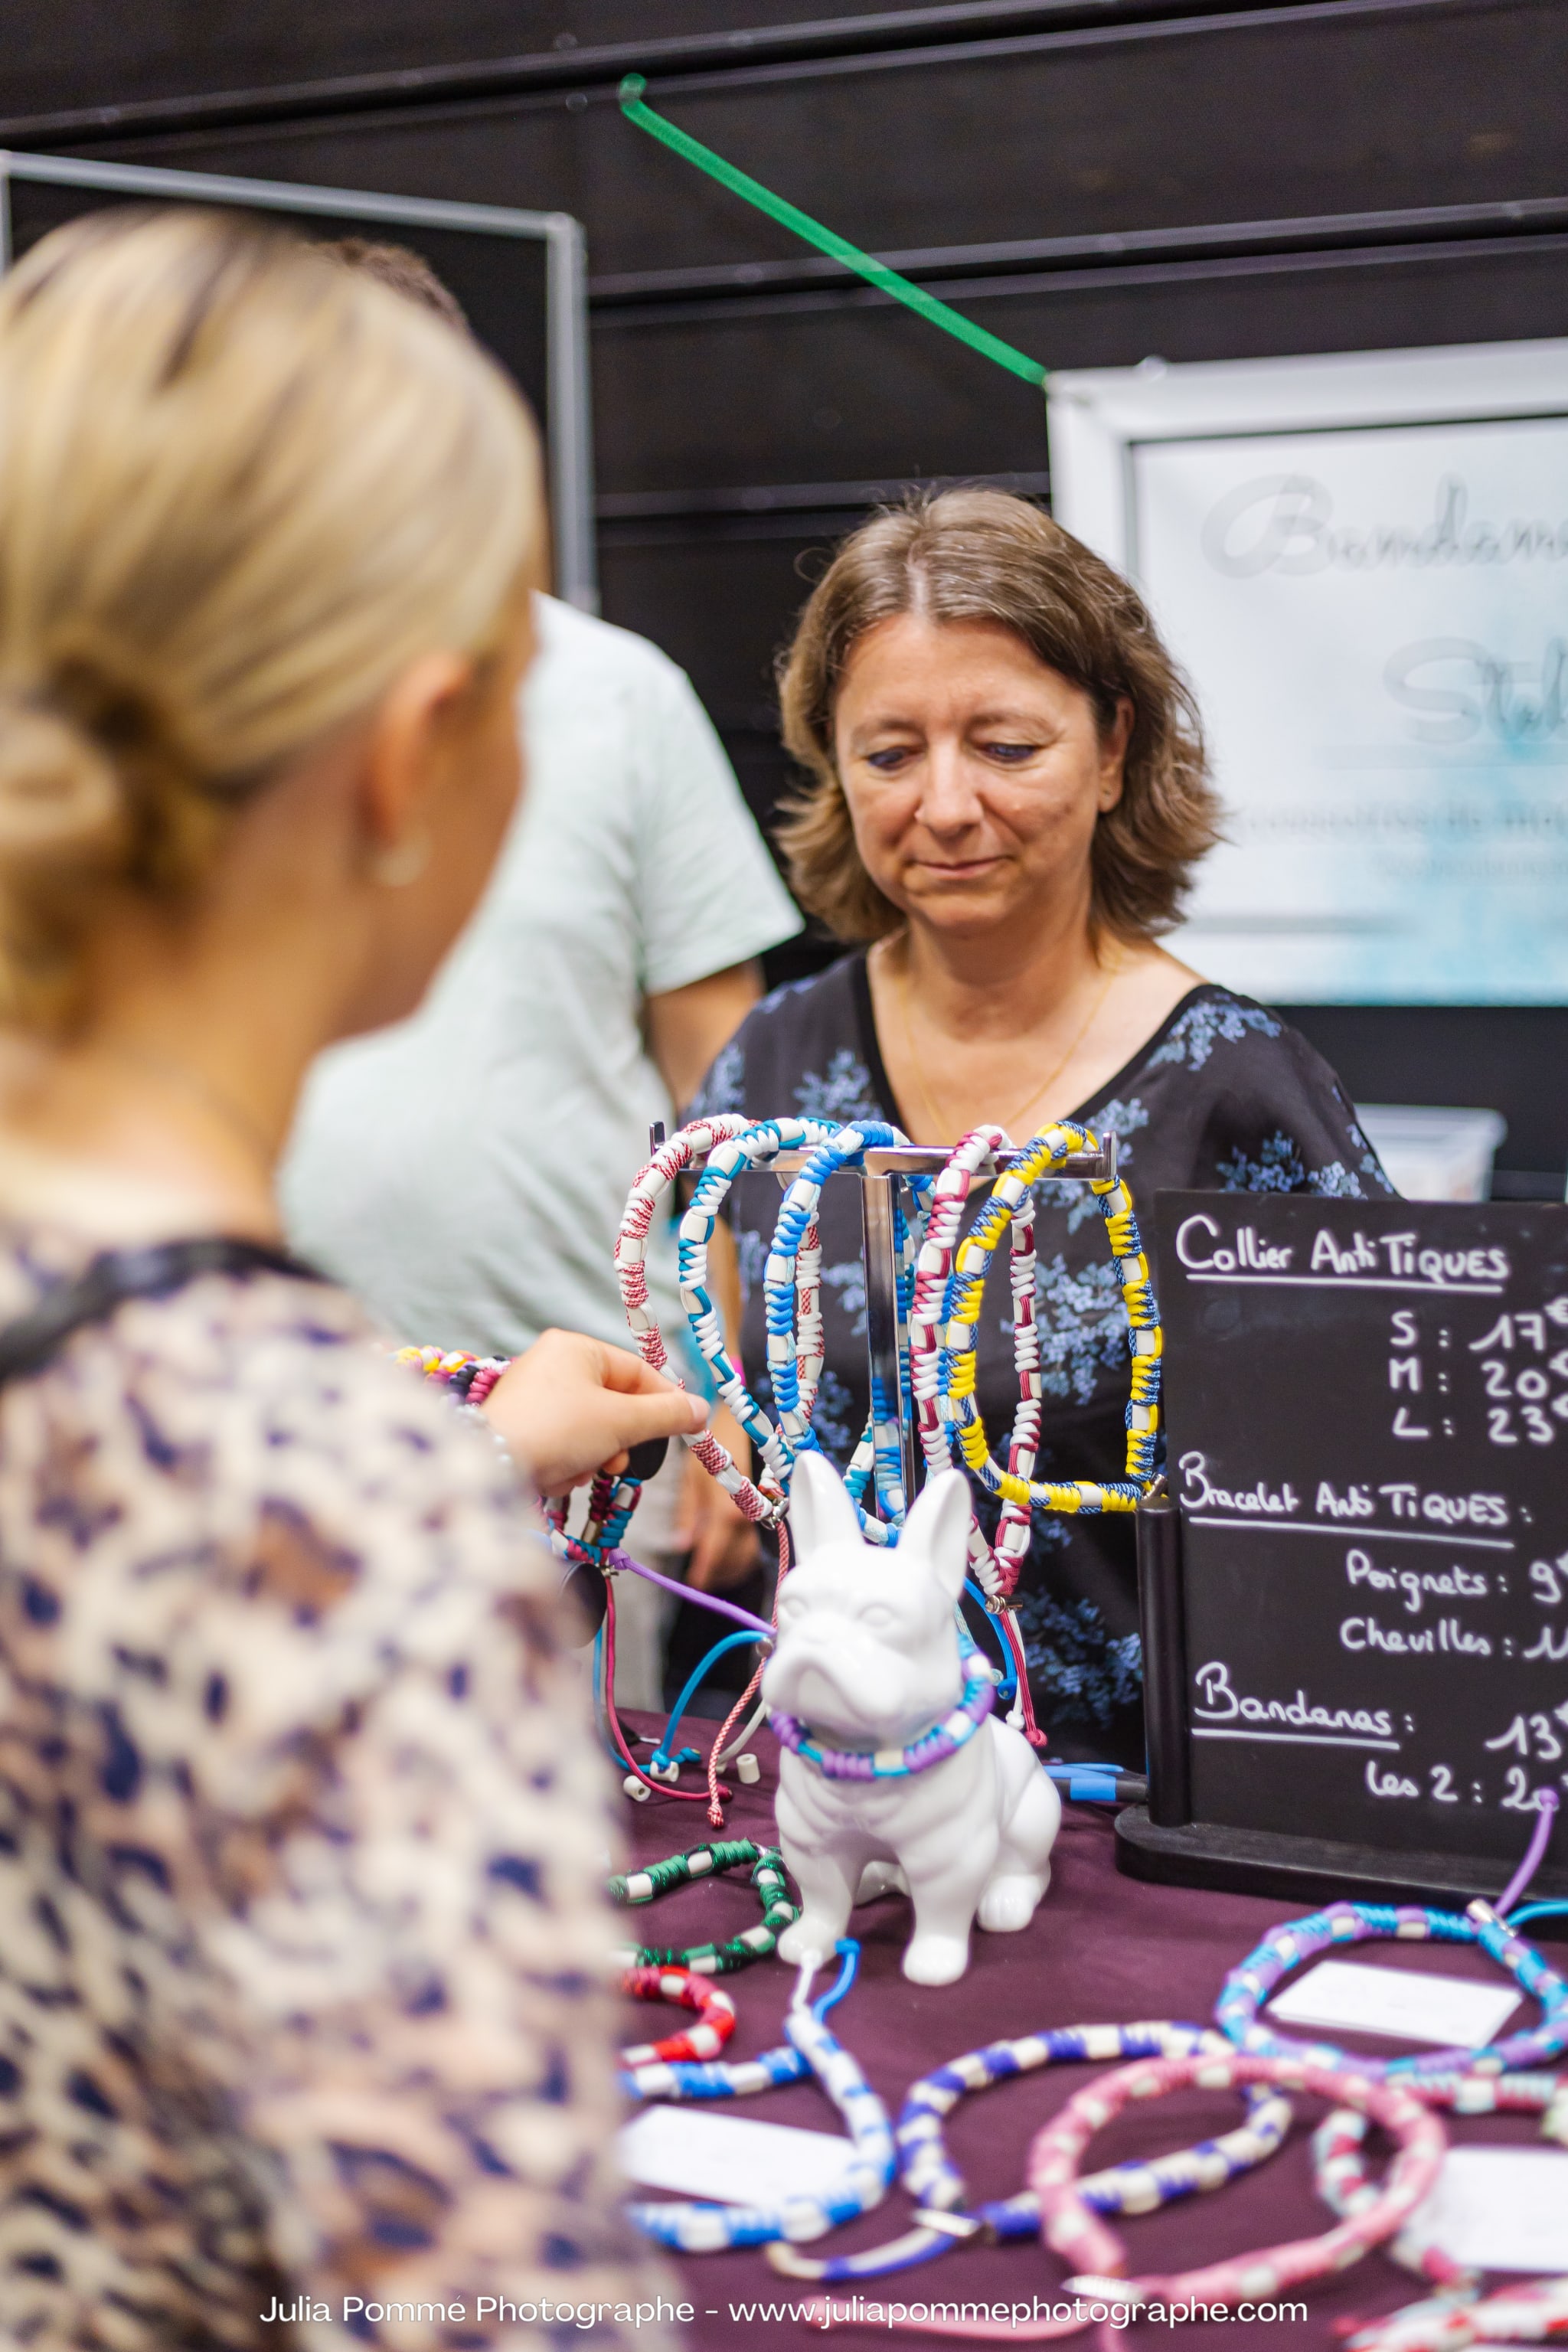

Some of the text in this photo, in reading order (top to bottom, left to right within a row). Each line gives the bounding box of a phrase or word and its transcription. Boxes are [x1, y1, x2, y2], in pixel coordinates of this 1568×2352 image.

[1201, 472, 1568, 576] Bandan
[1175, 1214, 1293, 1271] Collier
[1310, 1230, 1376, 1273] Anti
[1390, 1311, 1416, 1347] S
[1389, 1357, 1419, 1391] M
[1393, 1407, 1429, 1437] L
[1178, 1451, 1298, 1510] Bracelet
[1346, 1549, 1488, 1612] Poignets
[1340, 1618, 1491, 1655] Chevilles
[1194, 1661, 1392, 1735] Bandanas
[1431, 1765, 1459, 1802] 2
